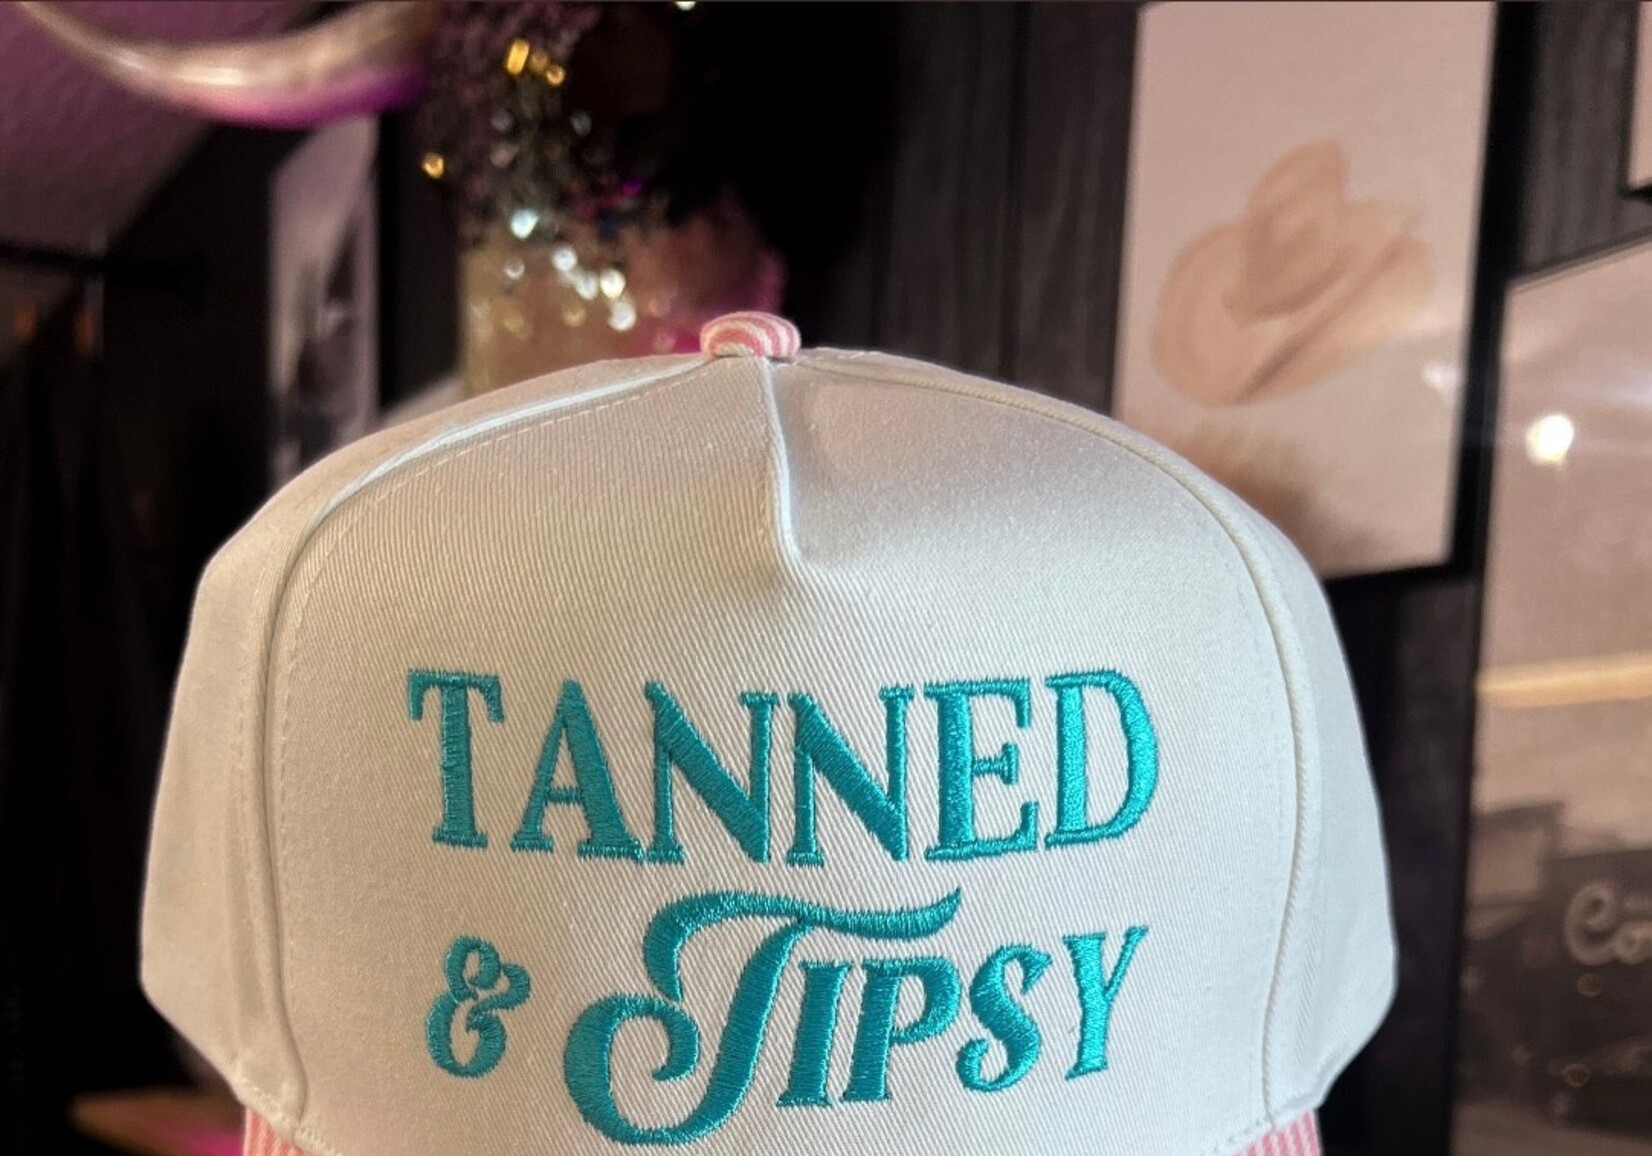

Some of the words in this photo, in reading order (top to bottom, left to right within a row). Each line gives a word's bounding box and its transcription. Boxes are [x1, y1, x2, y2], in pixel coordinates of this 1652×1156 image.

[409, 669, 1160, 866] TANNED
[428, 938, 530, 1077] &
[565, 888, 1149, 1146] TIPSY
